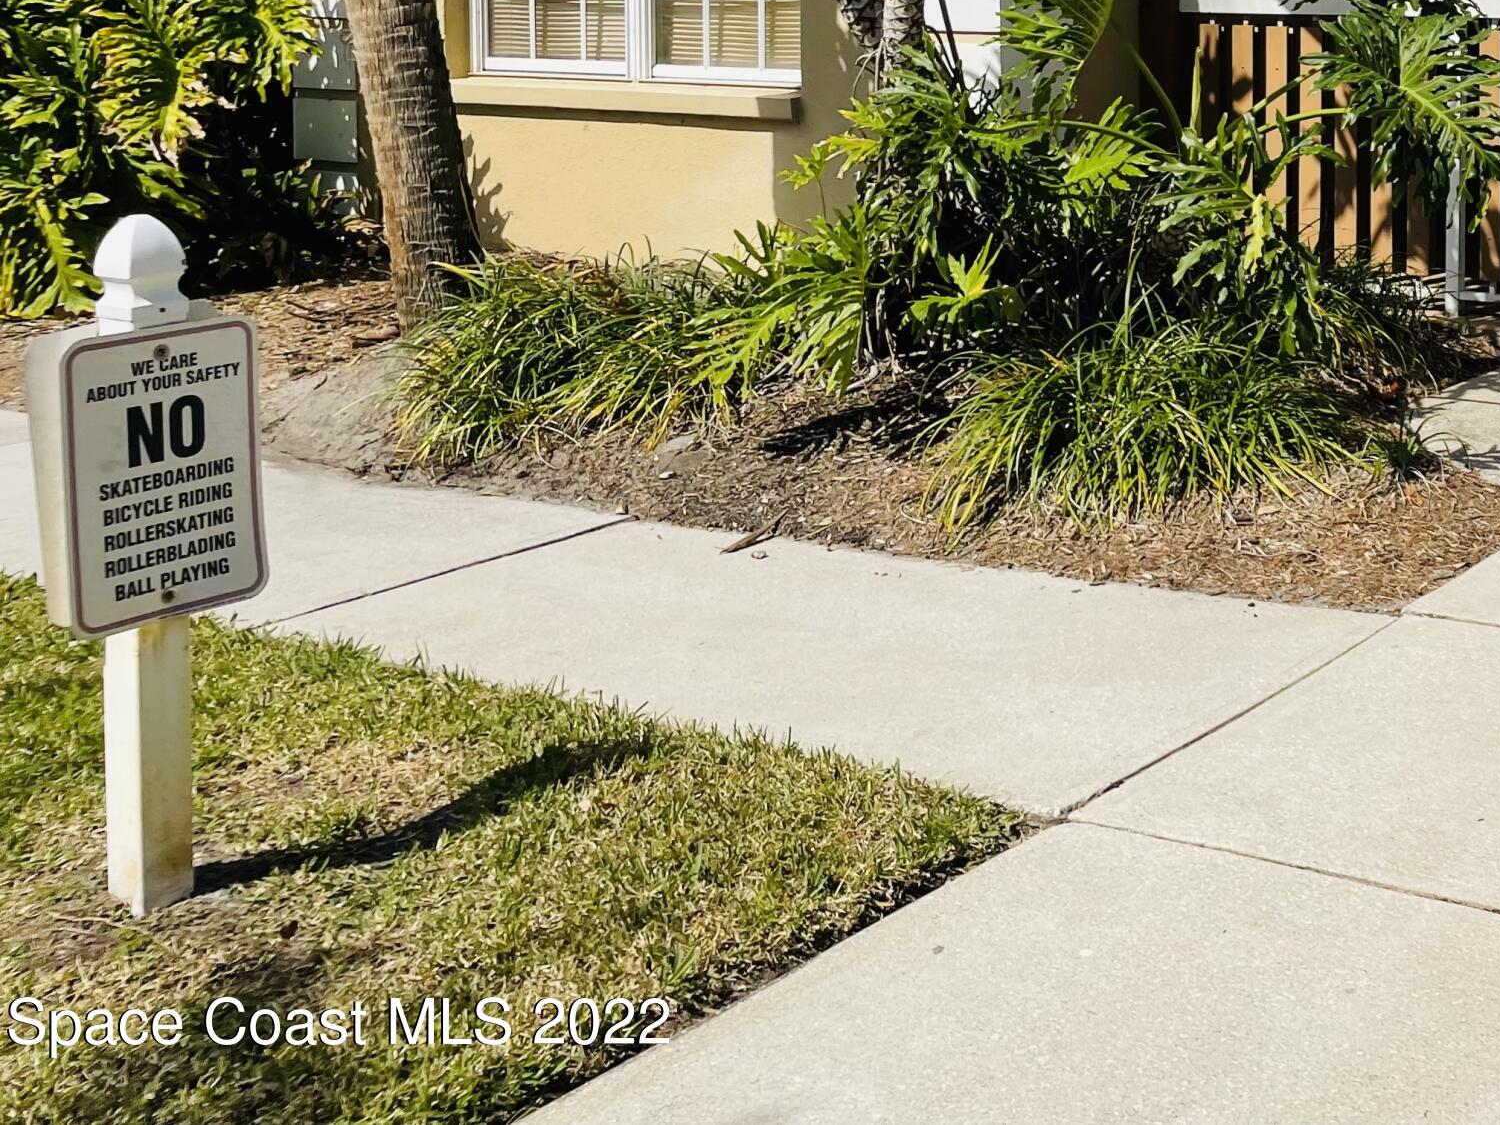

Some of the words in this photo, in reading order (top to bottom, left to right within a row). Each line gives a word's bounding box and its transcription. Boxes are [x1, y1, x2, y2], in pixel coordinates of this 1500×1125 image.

[86, 381, 136, 404] ABOUT
[143, 373, 181, 392] YOUR
[186, 362, 241, 385] SAFETY
[131, 359, 155, 377] WE
[159, 352, 199, 372] CARE
[127, 394, 205, 468] NO
[99, 457, 235, 501] SKATEBOARDING
[103, 495, 173, 527] BICYCLE
[179, 482, 233, 508] RIDING
[103, 506, 234, 553] ROLLERSKATING
[104, 531, 236, 578] ROLLERBLADING
[115, 581, 155, 602] BALL
[161, 558, 230, 589] PLAYING
